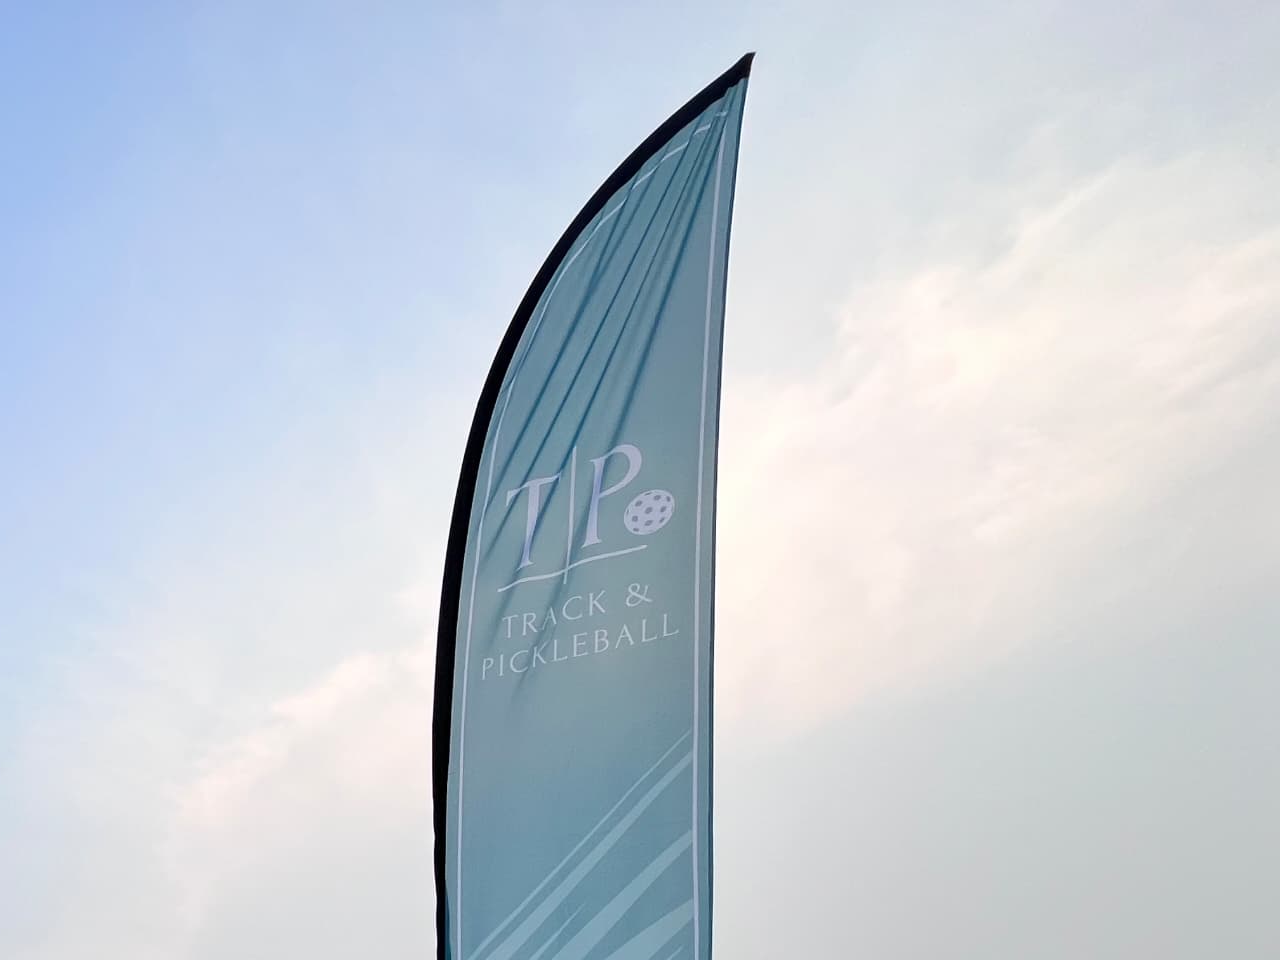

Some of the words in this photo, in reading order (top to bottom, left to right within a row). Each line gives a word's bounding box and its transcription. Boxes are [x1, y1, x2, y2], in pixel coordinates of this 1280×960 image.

[502, 590, 607, 639] TRACK
[625, 582, 653, 608] &
[481, 613, 680, 680] PICKLEBALL
